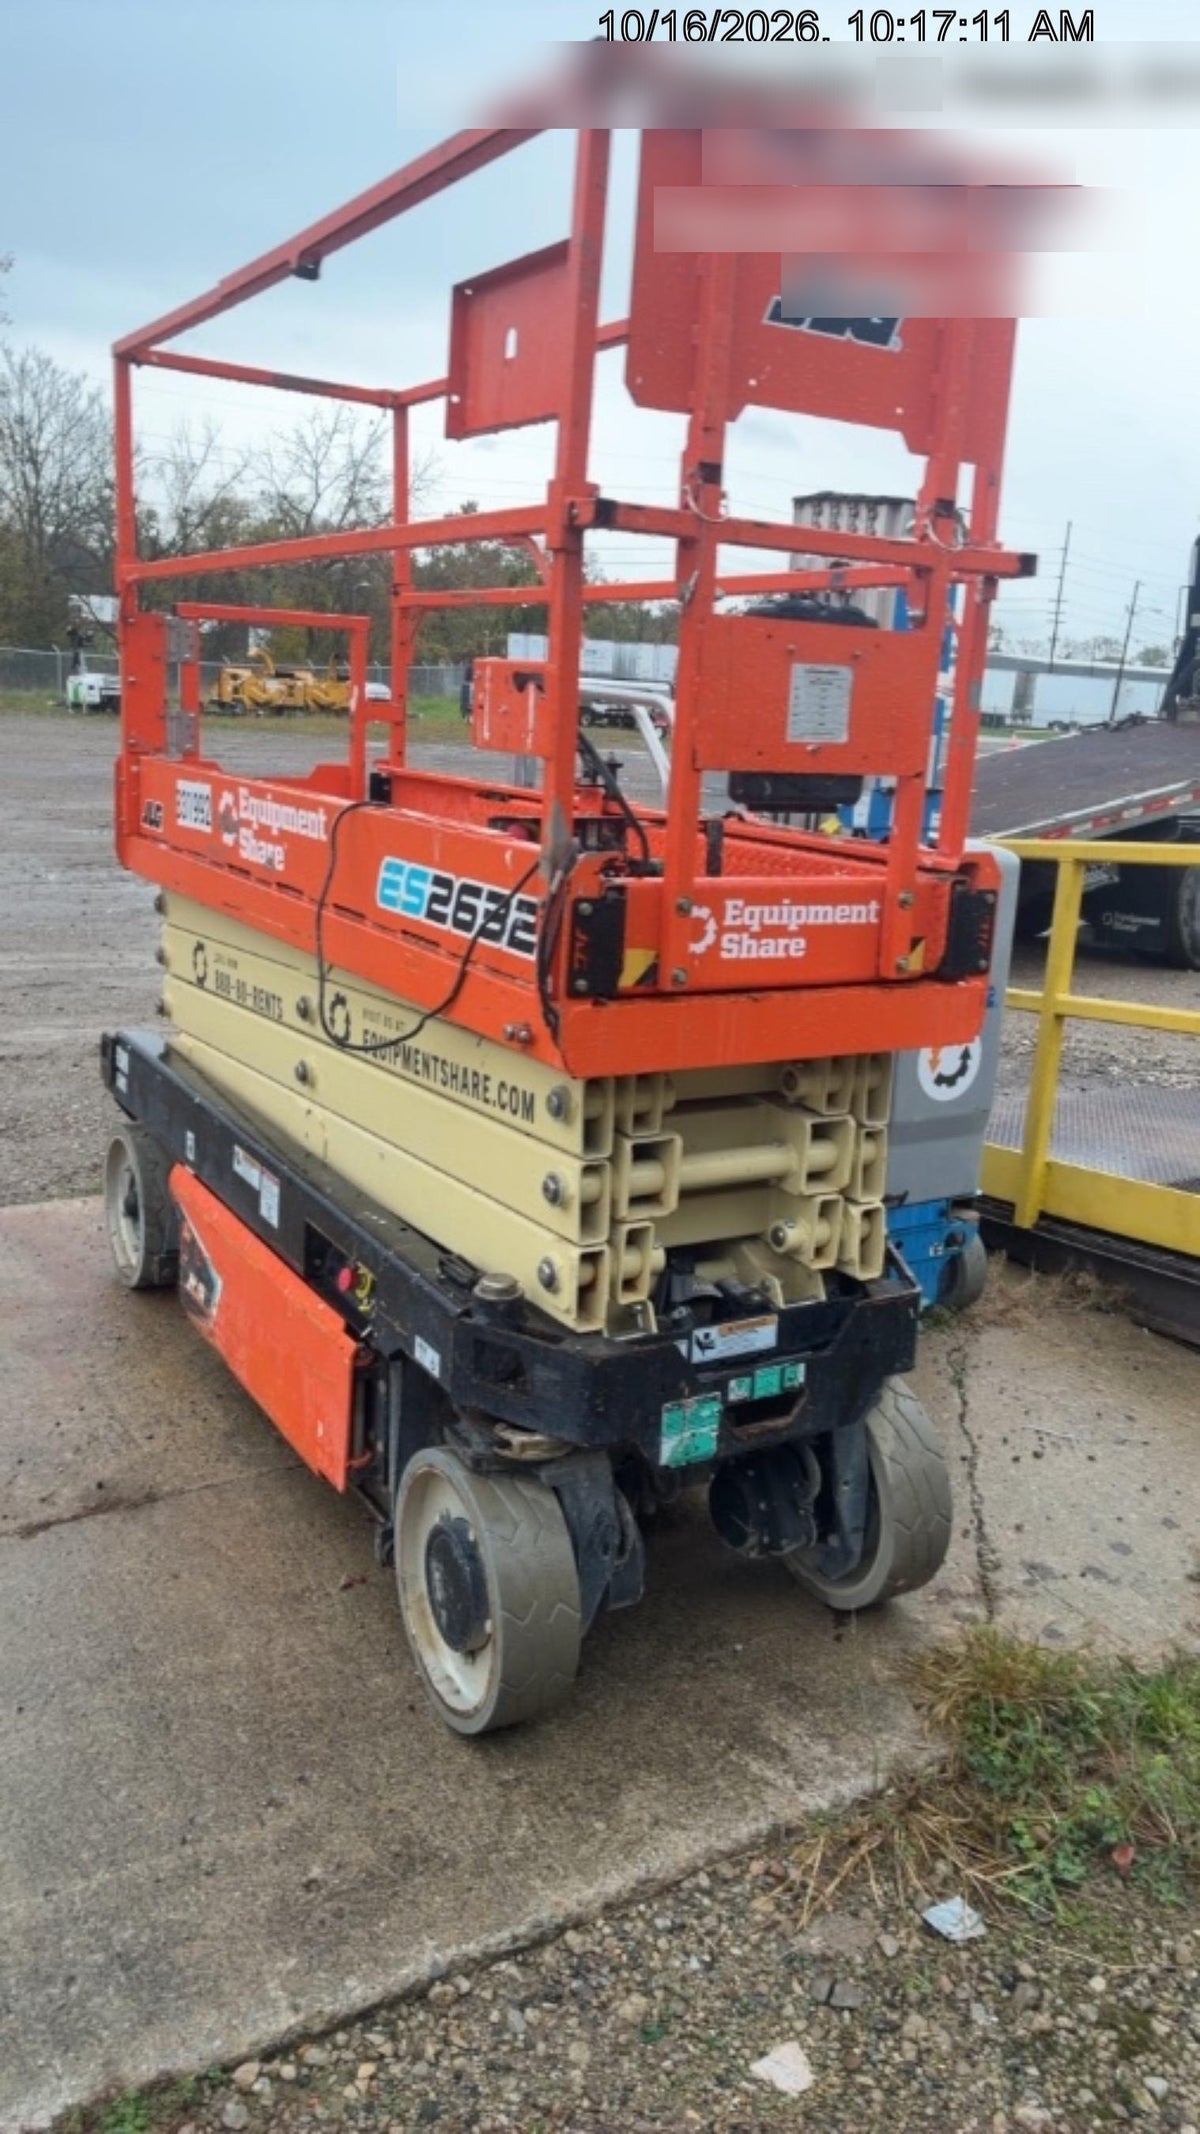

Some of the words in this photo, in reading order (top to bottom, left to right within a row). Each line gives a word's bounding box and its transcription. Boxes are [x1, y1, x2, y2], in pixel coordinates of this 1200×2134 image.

[238, 787, 328, 842] Equipment
[239, 827, 286, 872] Share
[377, 857, 538, 959] ES2632
[723, 899, 879, 929] Equipment
[720, 933, 806, 959] Share
[362, 1028, 535, 1124] EQUIPMENTSHARE.COM
